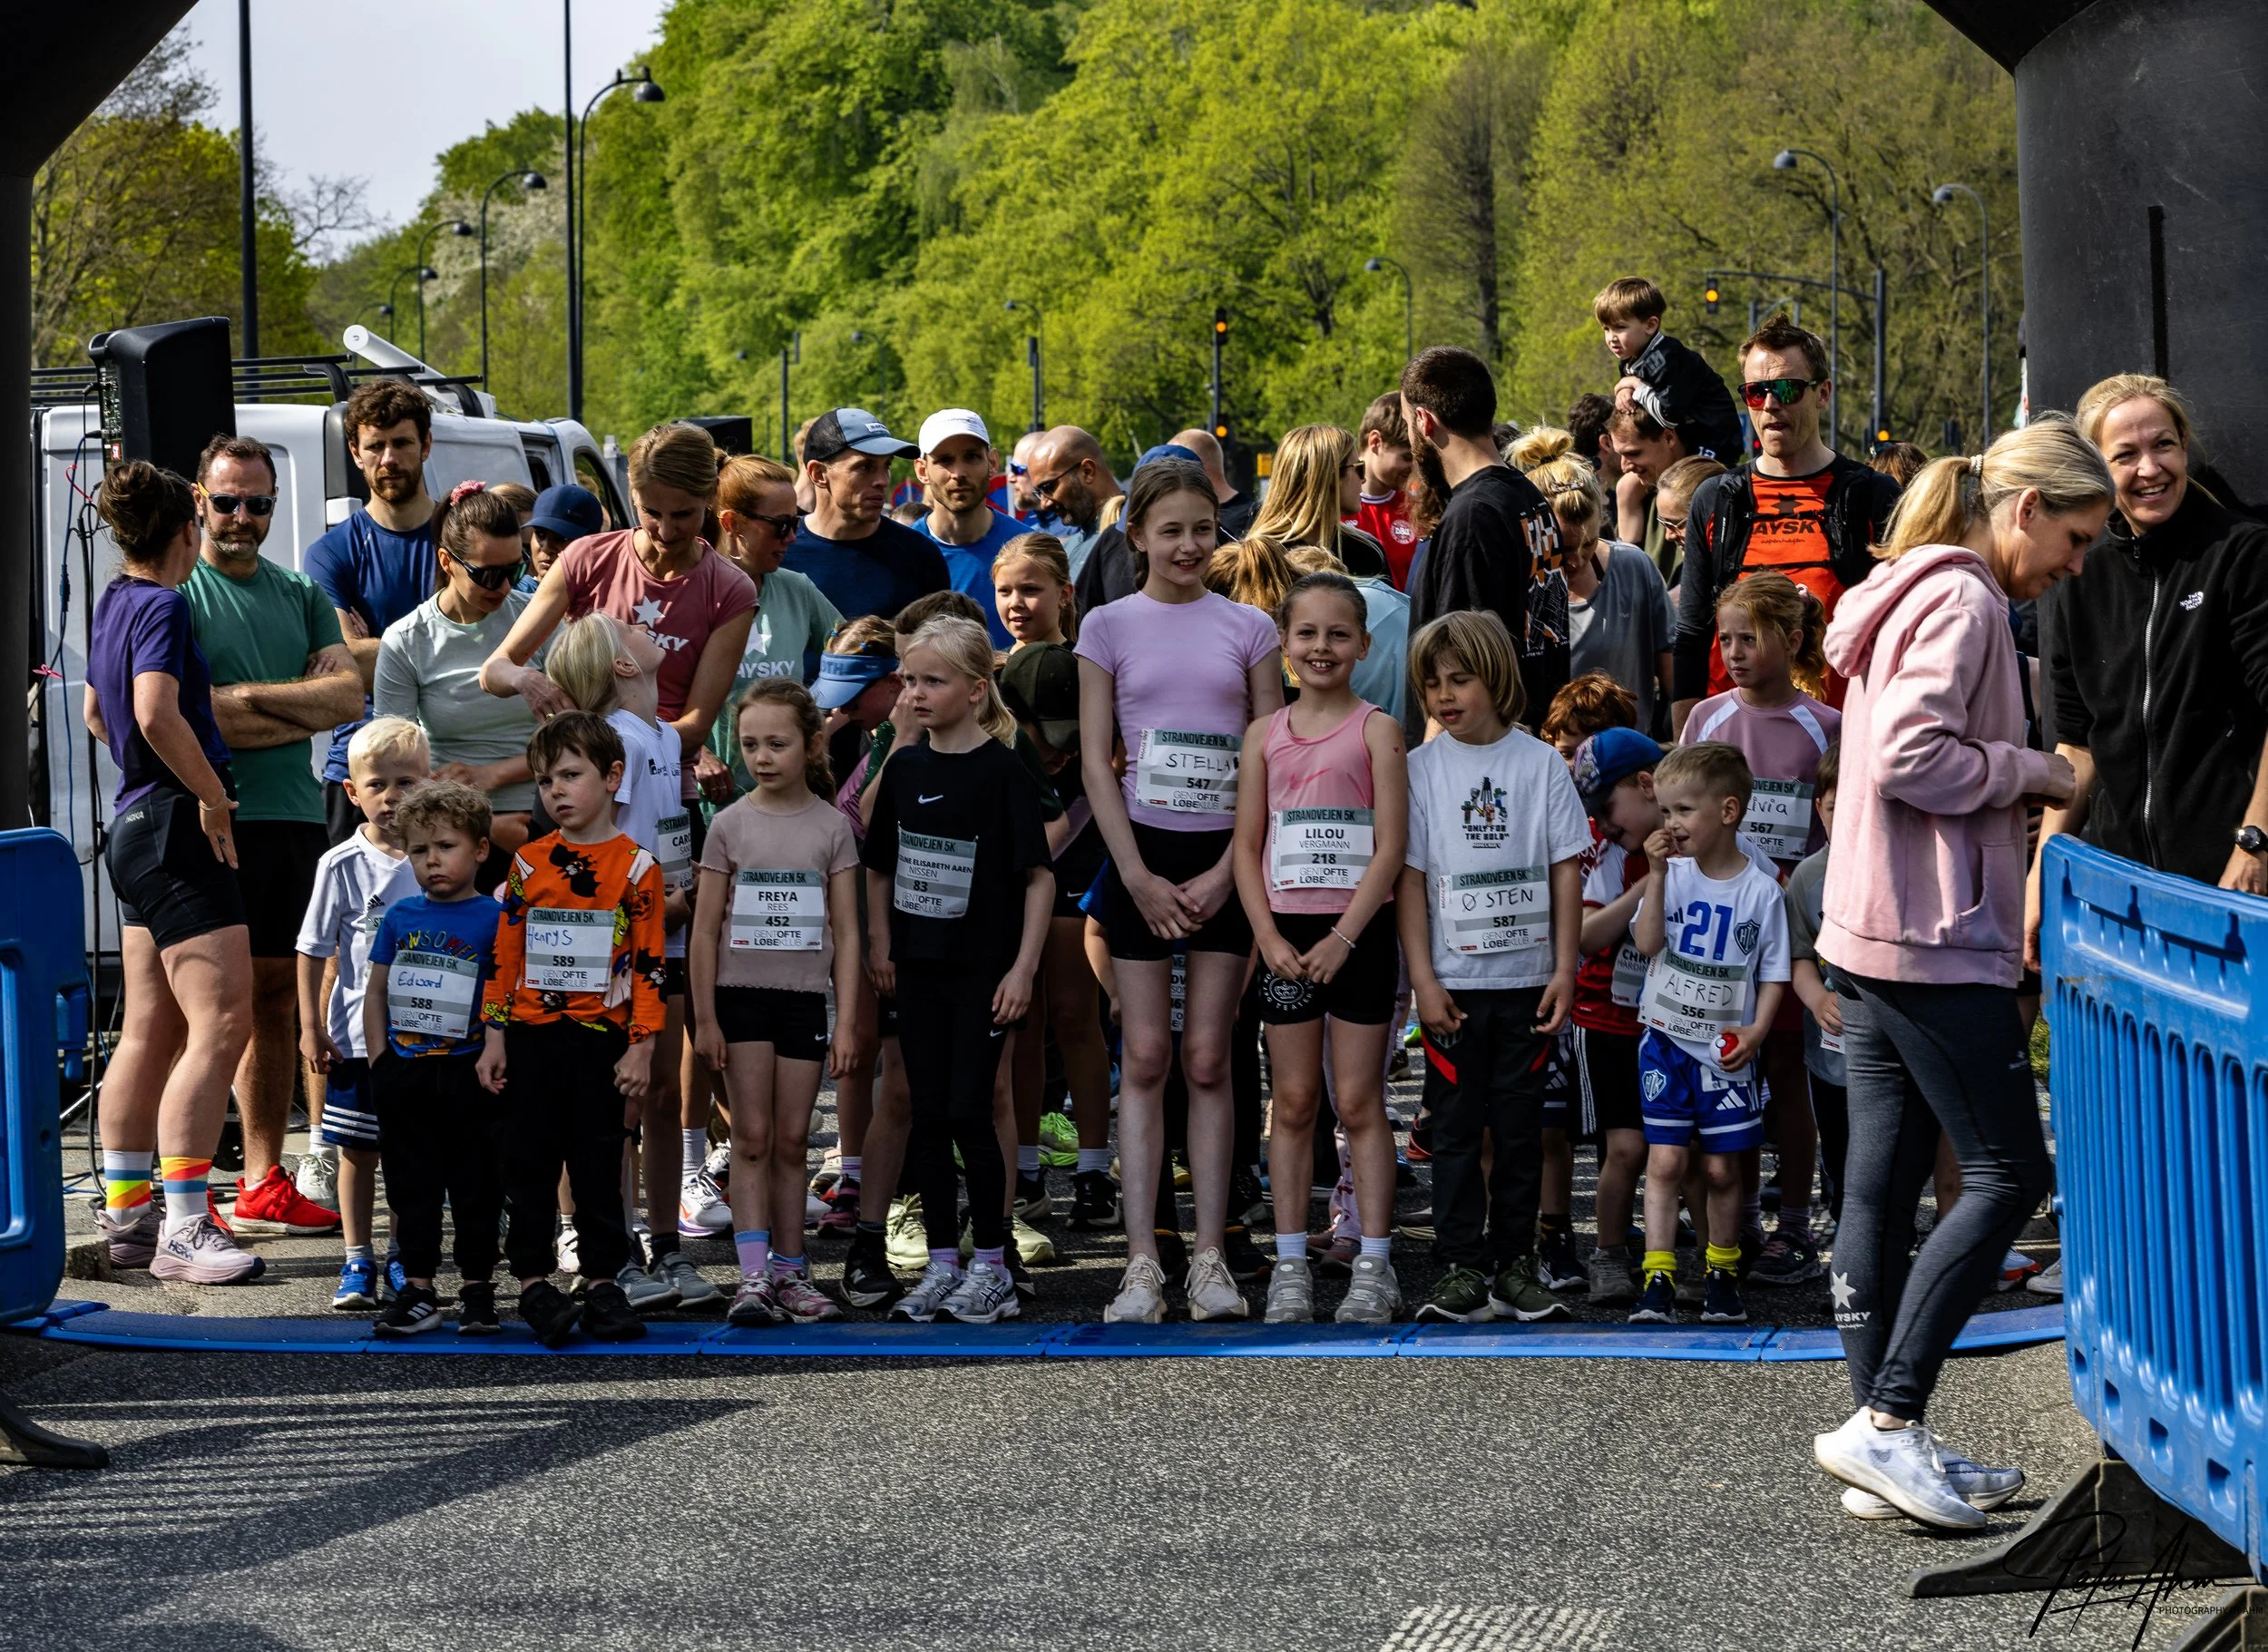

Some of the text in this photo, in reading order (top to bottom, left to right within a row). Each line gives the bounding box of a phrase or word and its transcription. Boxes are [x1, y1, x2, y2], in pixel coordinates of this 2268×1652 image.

[738, 660, 795, 679] AYSKY
[1161, 732, 1217, 747] STRANDVEJEN
[1218, 736, 1228, 748] 5K
[1166, 753, 1230, 772] STELLA
[1187, 777, 1211, 789] 547
[1784, 784, 1795, 794] 5K
[1173, 790, 1220, 802] GENTOFTE
[1173, 799, 1219, 810] LØBEKLUB
[1287, 809, 1343, 822] STRANDVEJEN
[1344, 810, 1355, 821] 5K
[1305, 828, 1344, 839] LILOU
[1750, 822, 1774, 834] 567
[943, 842, 955, 853] 5K
[1299, 840, 1350, 849] VERGMANN
[1312, 854, 1336, 864] 218
[908, 865, 937, 878] NISSEN
[913, 858, 951, 871] ELISABETH
[952, 865, 973, 874] AAEN
[1299, 867, 1348, 876] GENTOFTE
[742, 872, 807, 884] STRANDVEJEN 5K
[1299, 875, 1348, 885] LØBEKLUB
[1460, 871, 1528, 886] STRANDVEJEN 5K
[913, 880, 928, 892] 83
[758, 891, 798, 902] FREYA
[903, 891, 943, 906] GENTOFTE
[767, 903, 789, 912] REES
[902, 900, 942, 914] LØBEKLUB
[532, 910, 595, 923] STRANDVEJEN 5K
[765, 916, 790, 927] 452
[1492, 915, 1516, 927] 587
[754, 930, 802, 938] GENTOFTE
[1481, 929, 1529, 940] GENTOFTE
[1679, 900, 1734, 962] 21
[754, 938, 802, 946] LØBEKLUB
[1482, 938, 1529, 949] LØBEKLUB
[446, 958, 458, 970] 5K
[552, 955, 575, 967] 589
[1670, 955, 1730, 979] STRANDVEJEN 5K
[543, 969, 588, 979] GENTOFTE
[543, 977, 588, 988] LØBEKLUB
[1665, 973, 1734, 1007] ALFRED
[411, 997, 433, 1010] 588
[400, 1010, 443, 1022] GENTOFTE
[1681, 1005, 1706, 1019] 556
[400, 1019, 443, 1031] LØBEKLUB
[1669, 1014, 1716, 1031] GENTOFTE
[1667, 1024, 1717, 1040] LØBEKLUB
